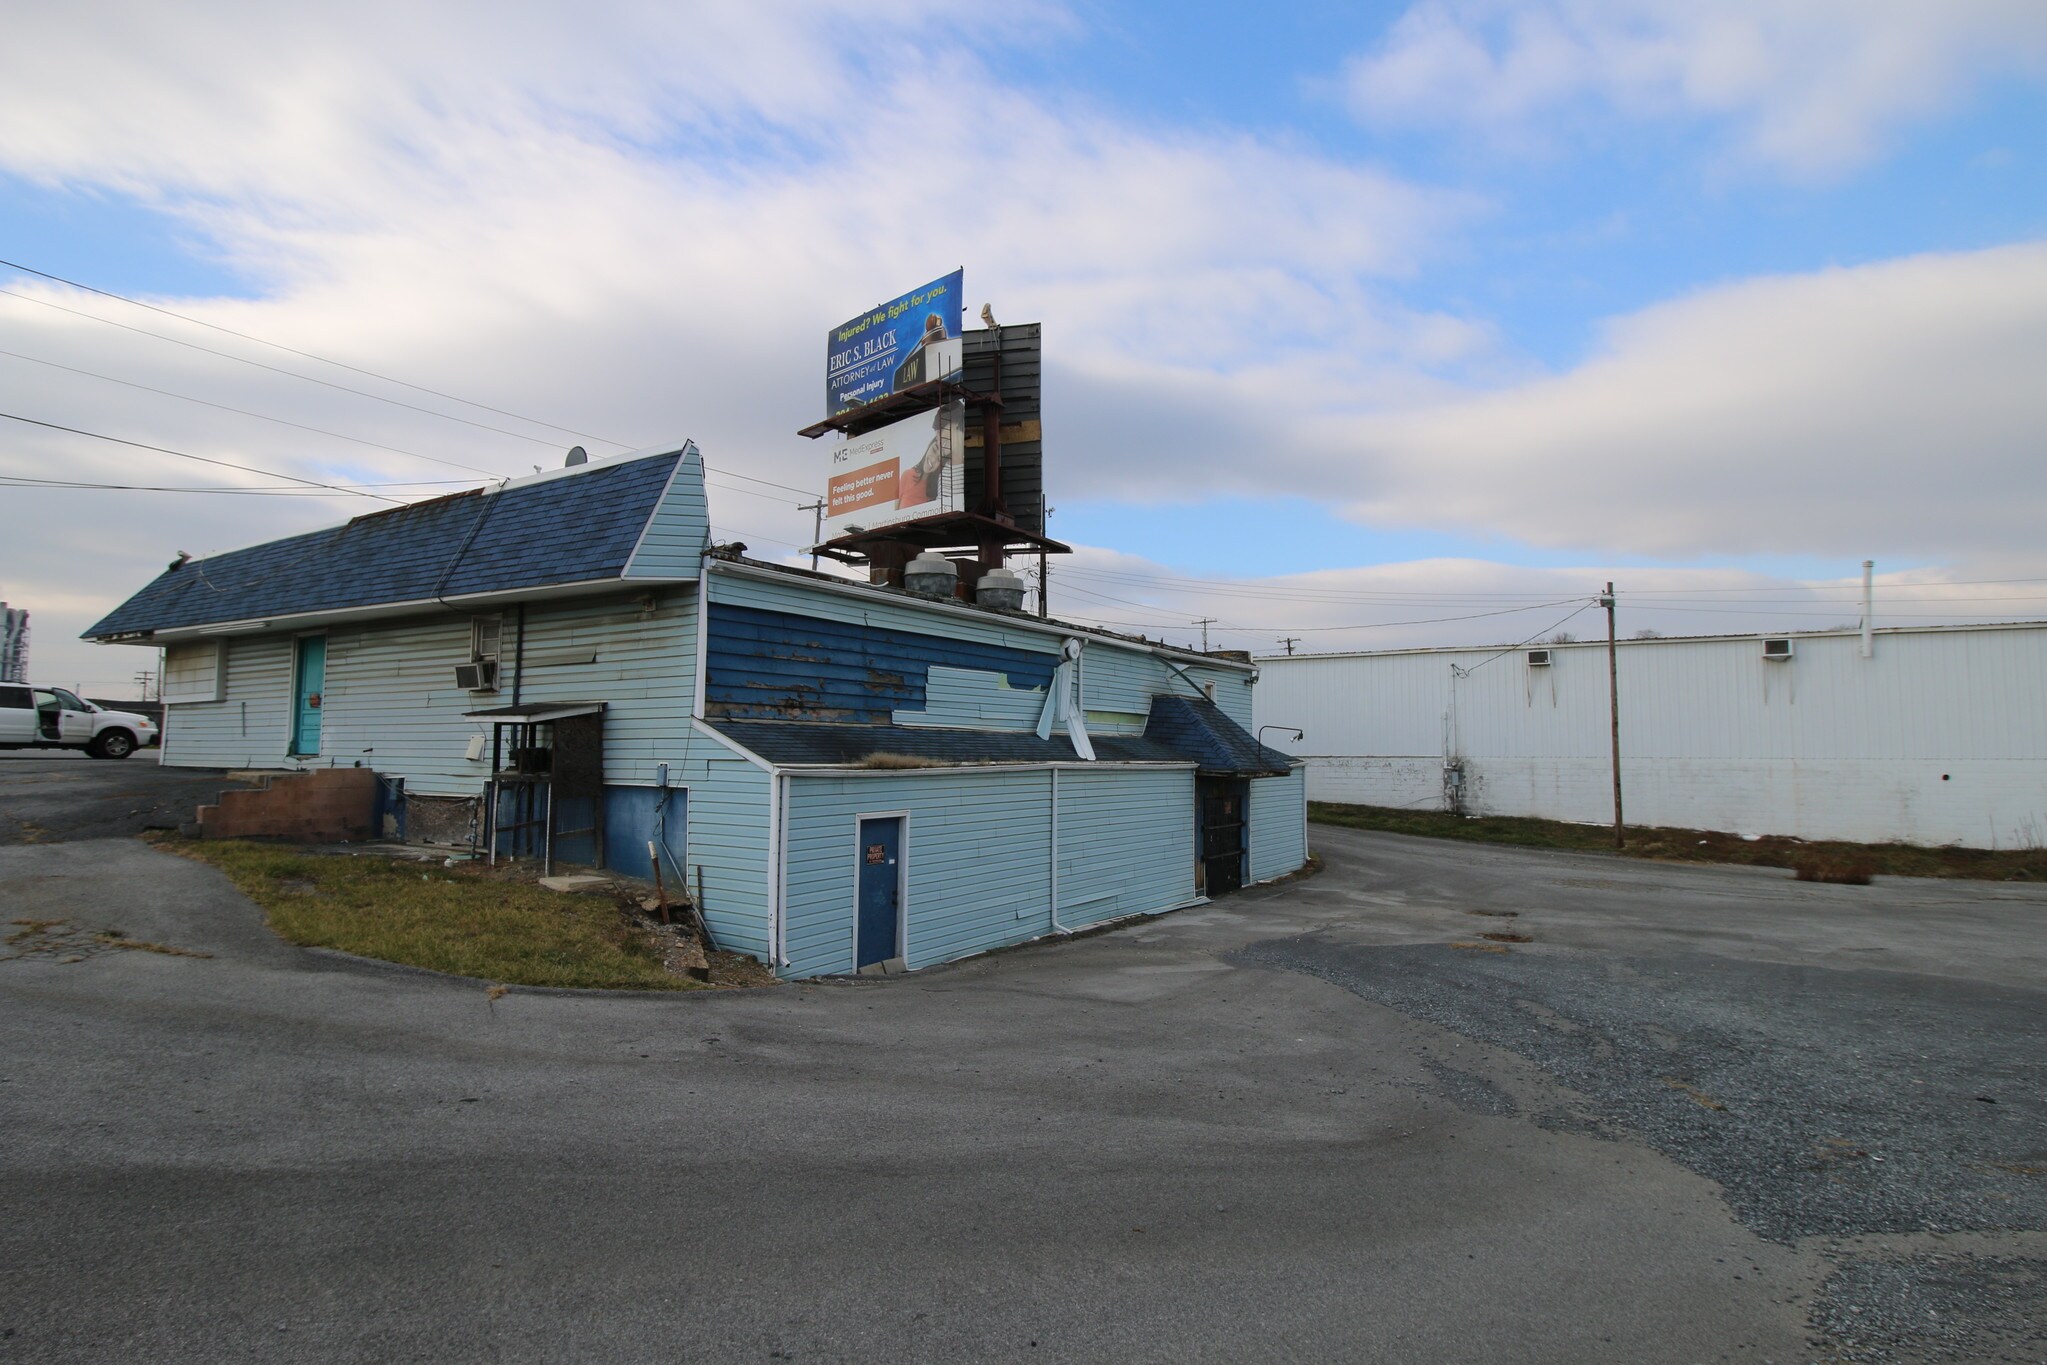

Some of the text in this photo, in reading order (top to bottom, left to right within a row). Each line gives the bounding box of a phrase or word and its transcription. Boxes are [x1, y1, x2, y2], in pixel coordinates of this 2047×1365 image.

[839, 285, 947, 342] Injured? We fight for you.
[830, 329, 897, 371] ERIC S. BLACK
[831, 365, 870, 390] ATTORNEY
[877, 355, 895, 371] LAW
[903, 358, 919, 383] LAW
[840, 378, 885, 402] Personal Injury
[849, 439, 884, 455] MedExpress
[832, 470, 894, 495] Feeling better never
[832, 488, 874, 507] felt this good.
[912, 505, 947, 520] Commons
[867, 852, 884, 860] PROPERTY
